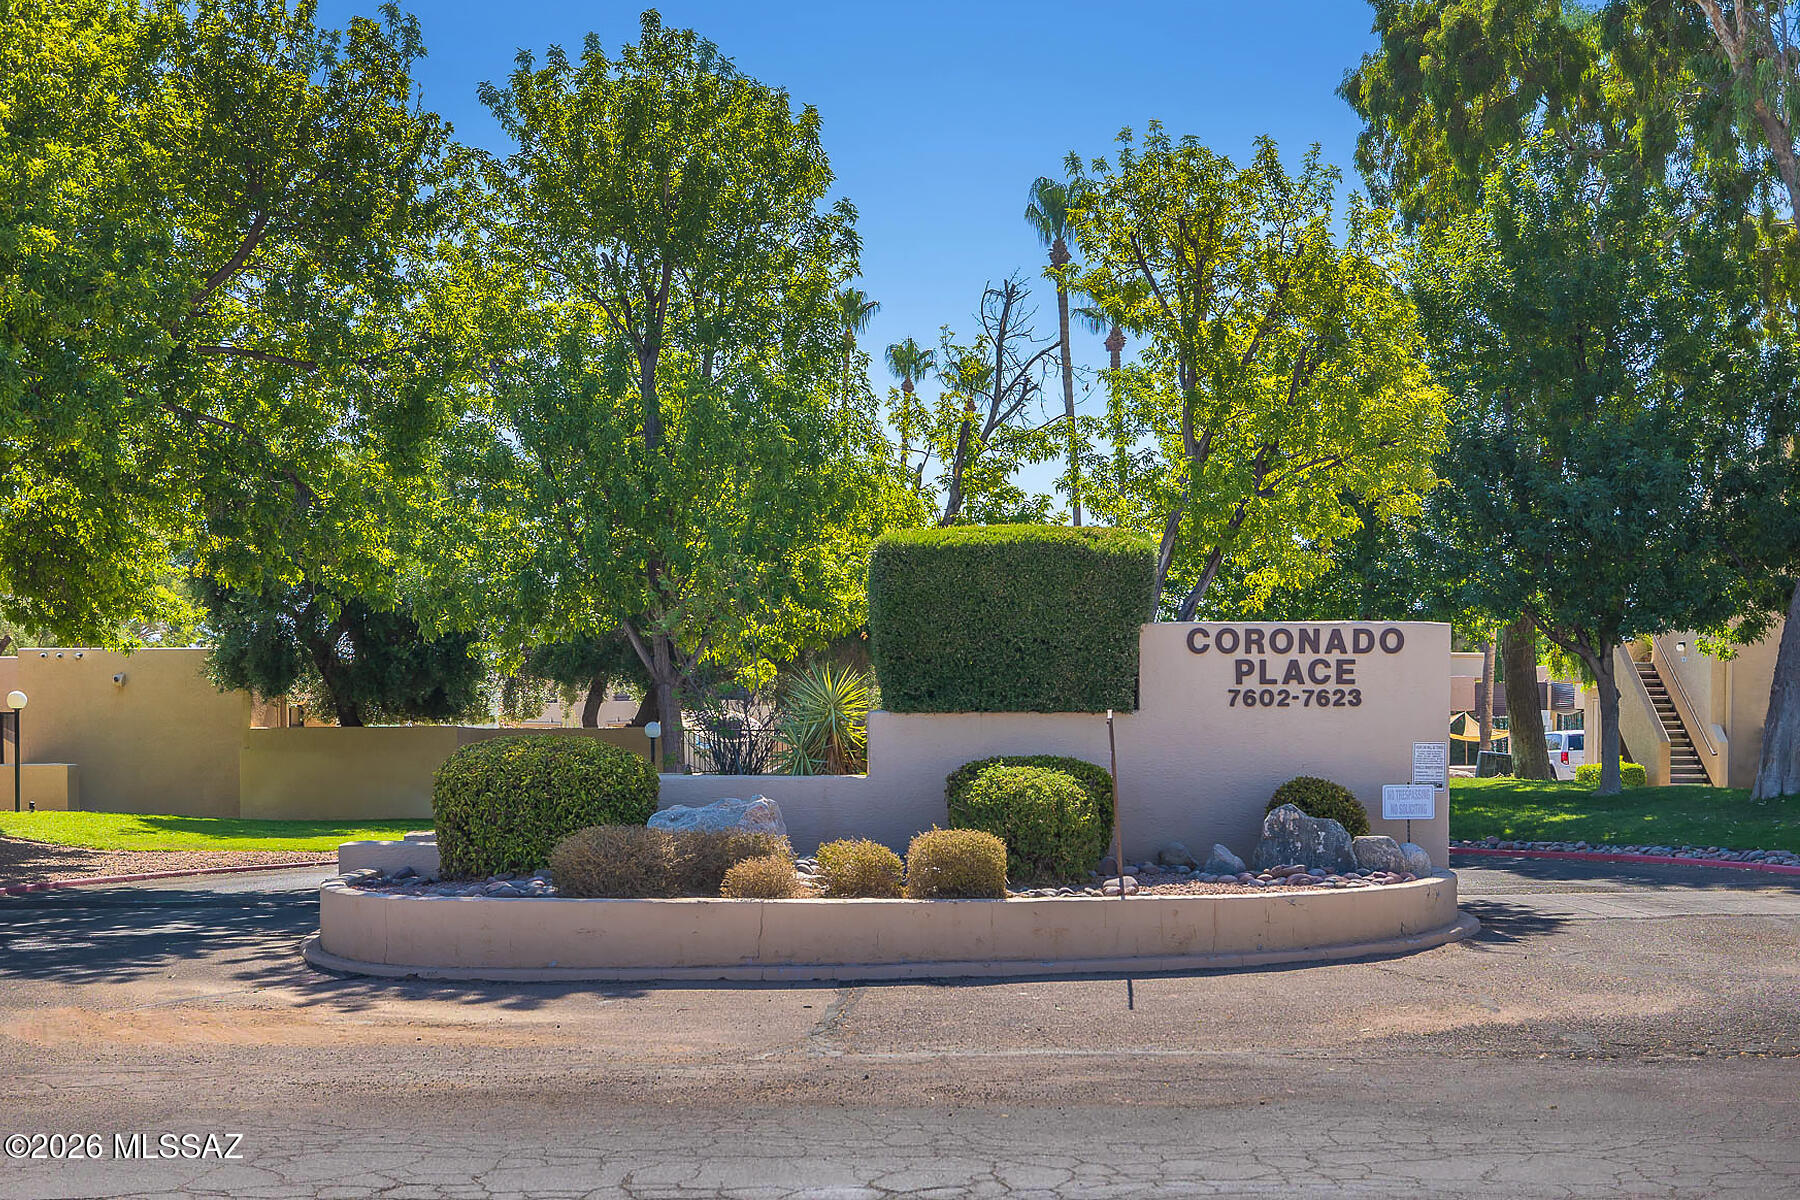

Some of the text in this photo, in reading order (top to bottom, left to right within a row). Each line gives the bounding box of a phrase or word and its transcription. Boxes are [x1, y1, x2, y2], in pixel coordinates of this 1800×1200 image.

[1186, 627, 1405, 654] CORONADO
[1234, 658, 1356, 685] PLACE
[1227, 689, 1362, 707] 7602-7623
[1387, 789, 1430, 800] NO TRESPASSING
[1391, 803, 1428, 815] NO SOLICITING
